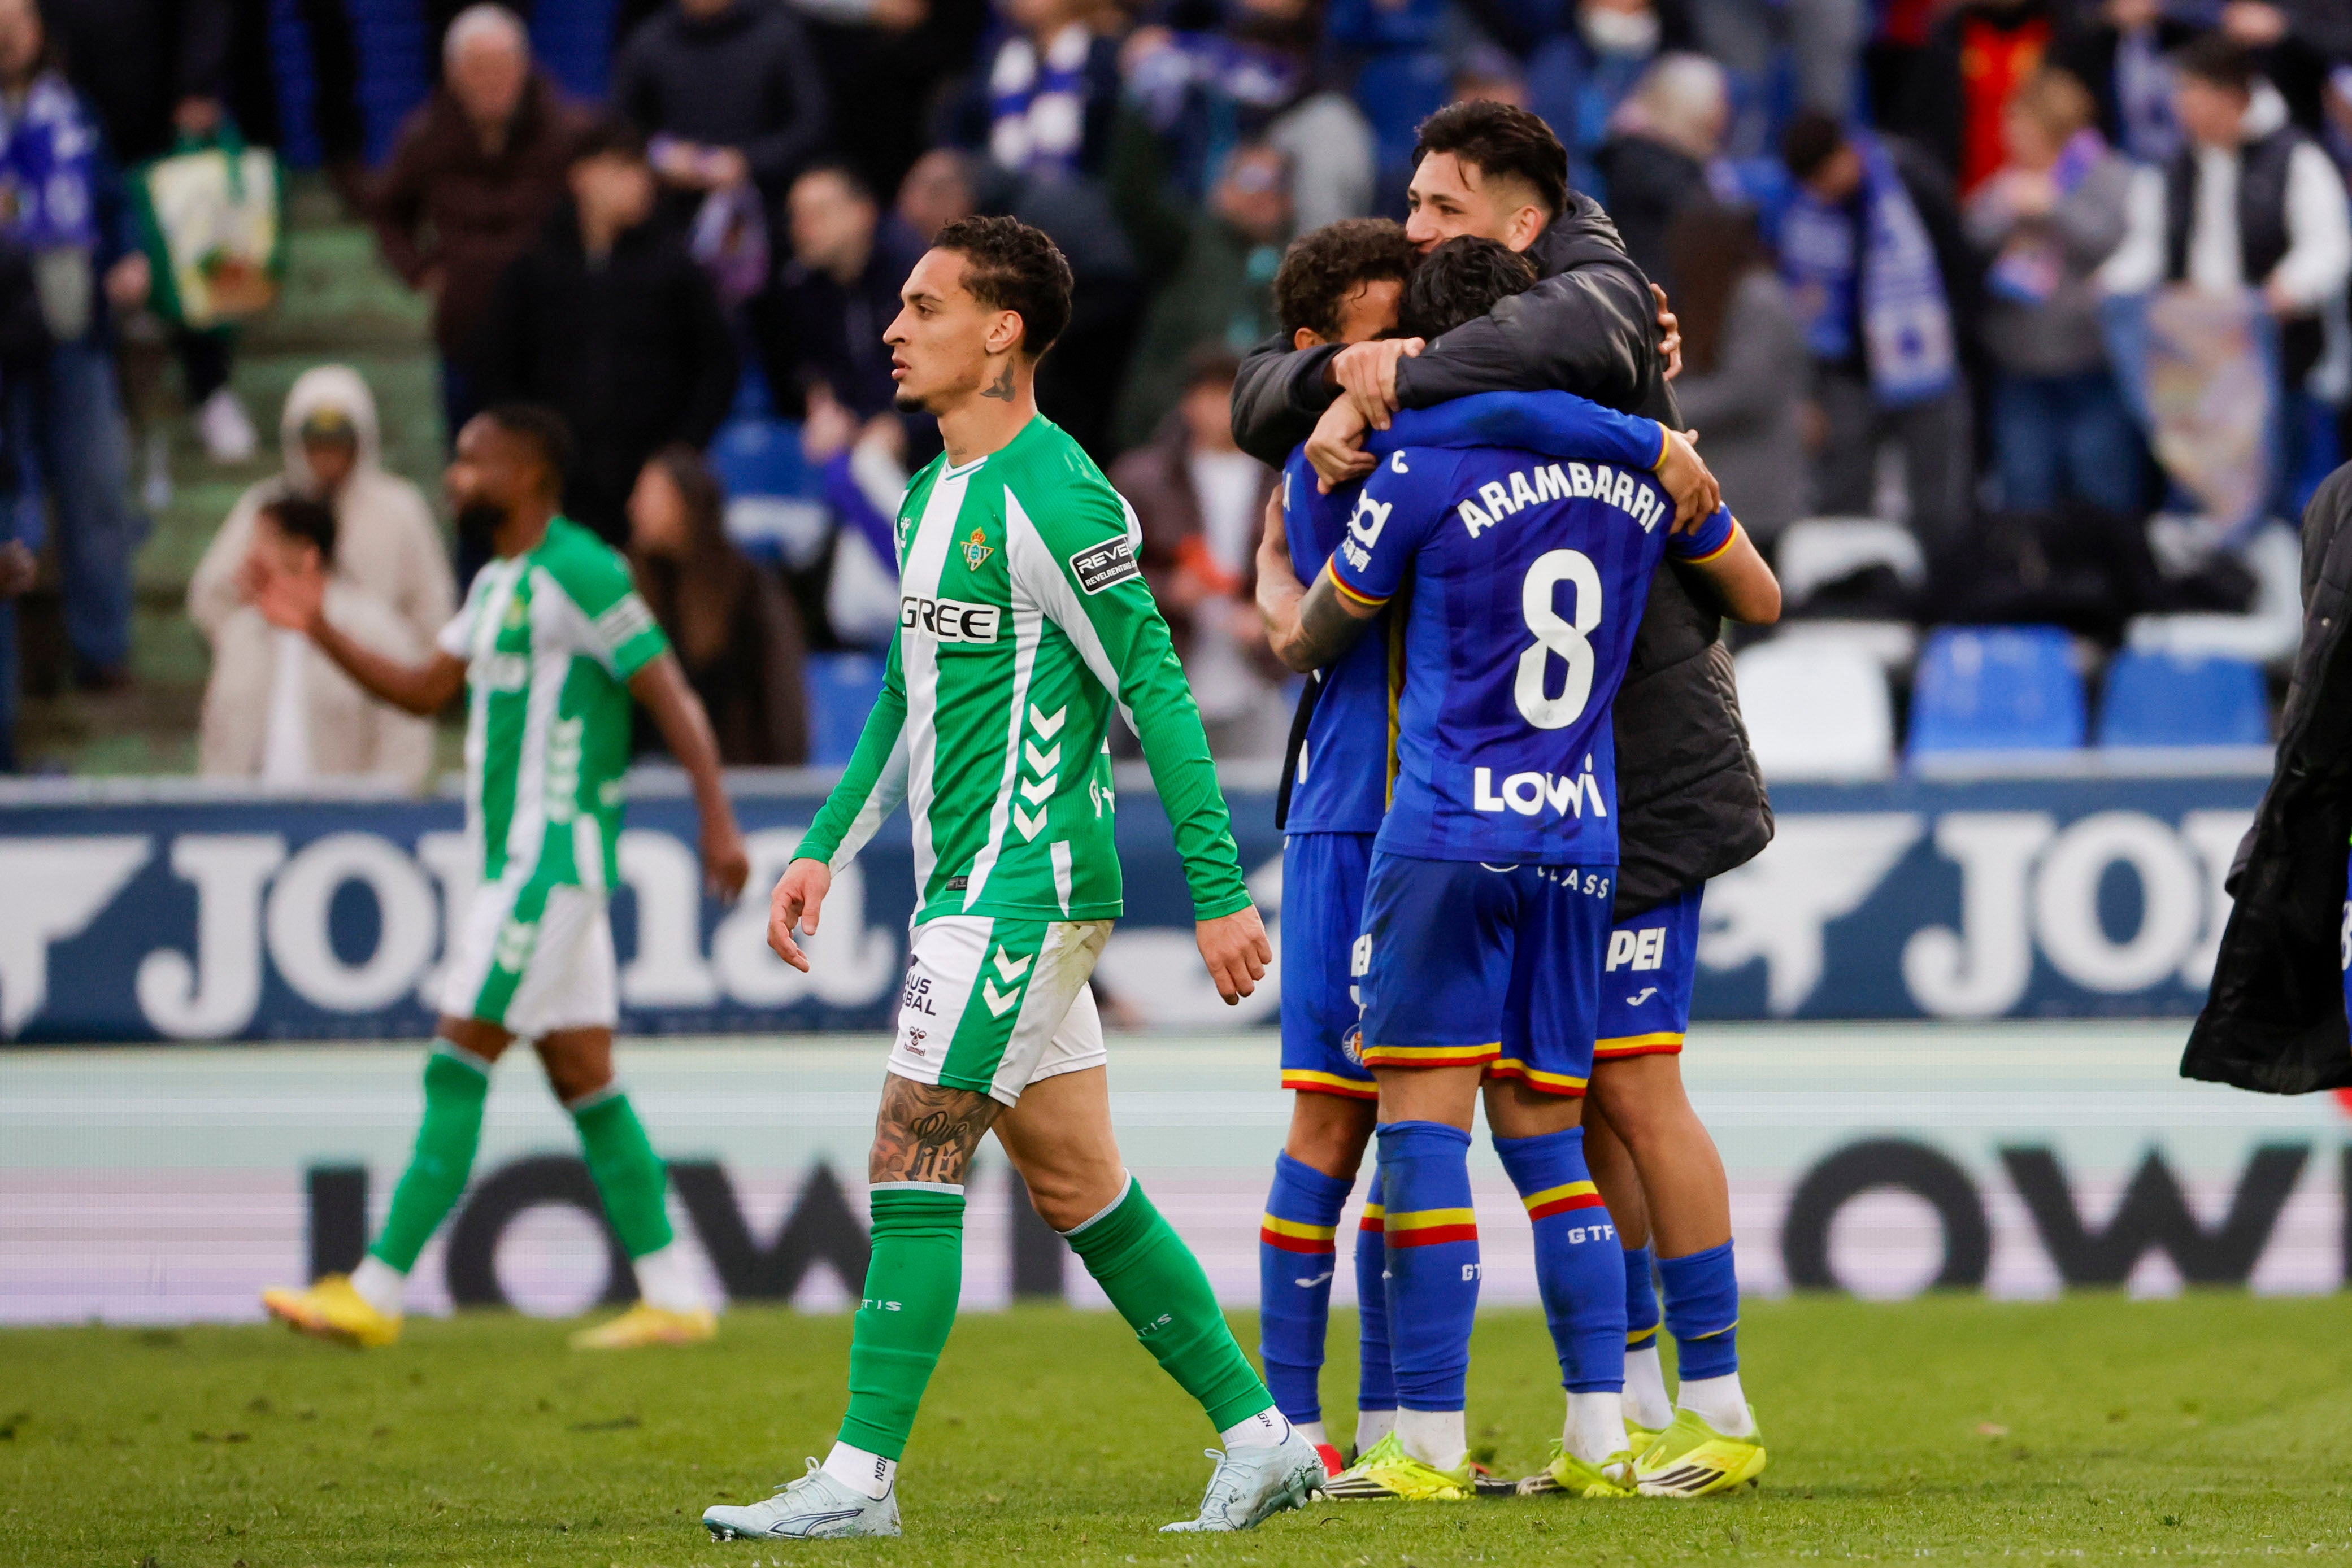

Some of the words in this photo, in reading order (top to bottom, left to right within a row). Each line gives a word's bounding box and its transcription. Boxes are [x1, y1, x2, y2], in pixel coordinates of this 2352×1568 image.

[1457, 461, 1666, 539] ARAMBARRI
[902, 596, 993, 638] GREE
[1514, 548, 1602, 729] 8
[1606, 927, 1666, 972] PEI
[905, 989, 936, 1016] BAL
[862, 1299, 902, 1312] TIS
